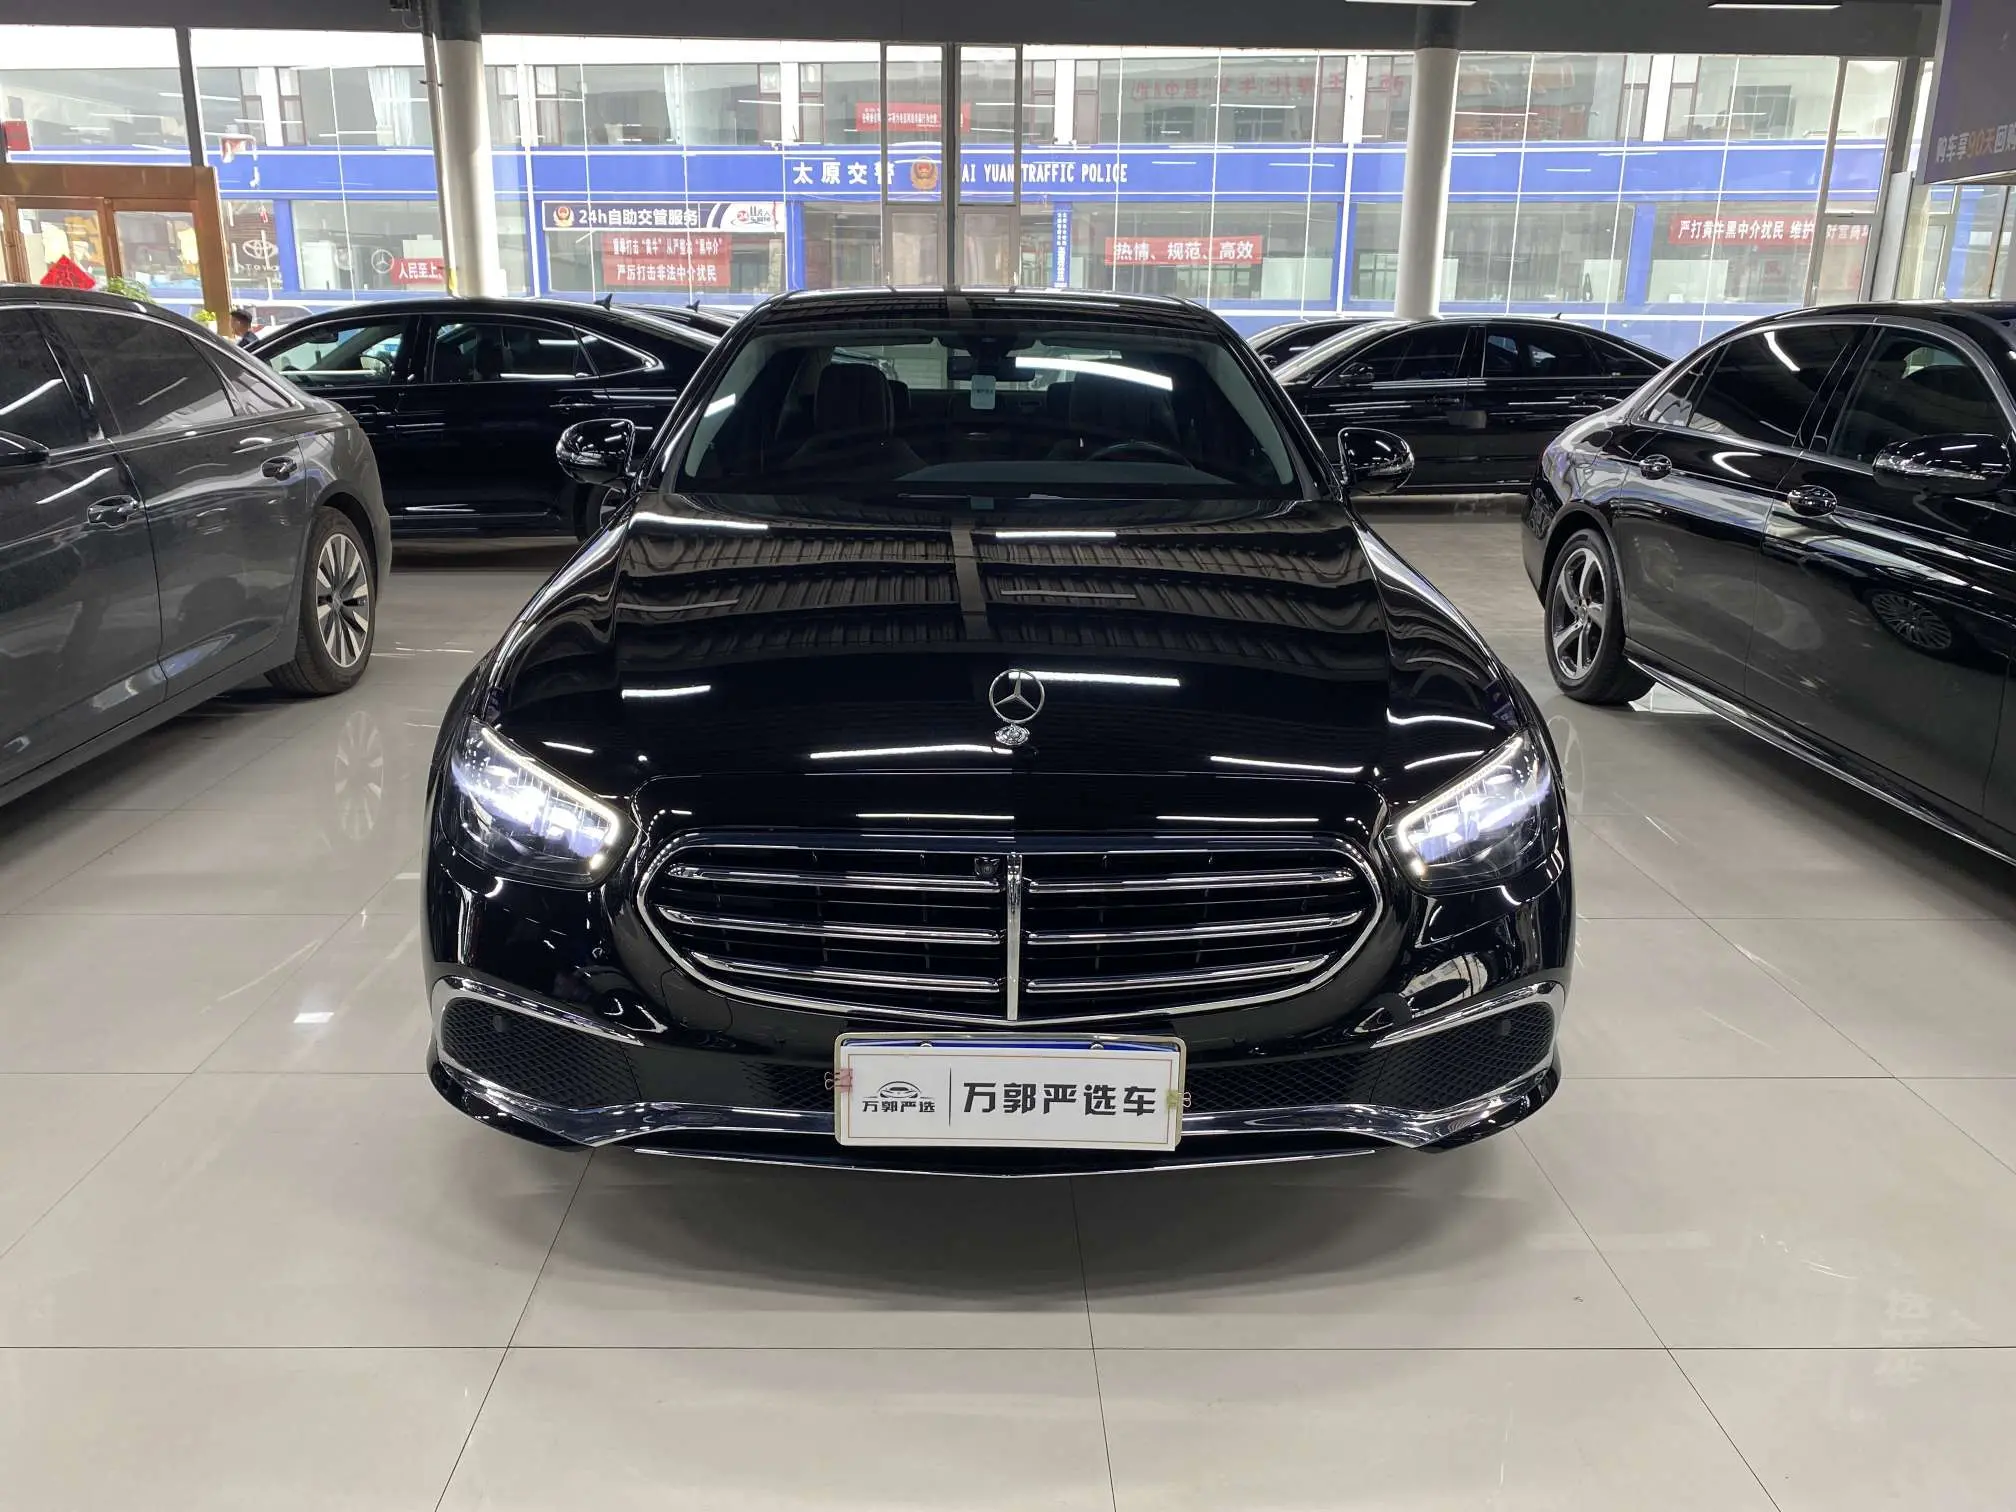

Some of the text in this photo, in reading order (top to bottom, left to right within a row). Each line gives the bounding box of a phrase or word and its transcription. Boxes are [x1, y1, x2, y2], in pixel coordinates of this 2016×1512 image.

[793, 161, 895, 185] 太原交警
[962, 163, 1129, 183] AI YUAN TRAFFIC POLICE
[579, 208, 698, 226] 24h自助交管服务
[1678, 220, 1785, 239] 严打黄牛黑中介扰民
[1115, 240, 1254, 261] 热情、规范、高效
[617, 263, 717, 281] 严厉打击非法中介扰民
[862, 1100, 936, 1113] 万郭严选
[963, 1082, 1157, 1116] 万郭严选车
